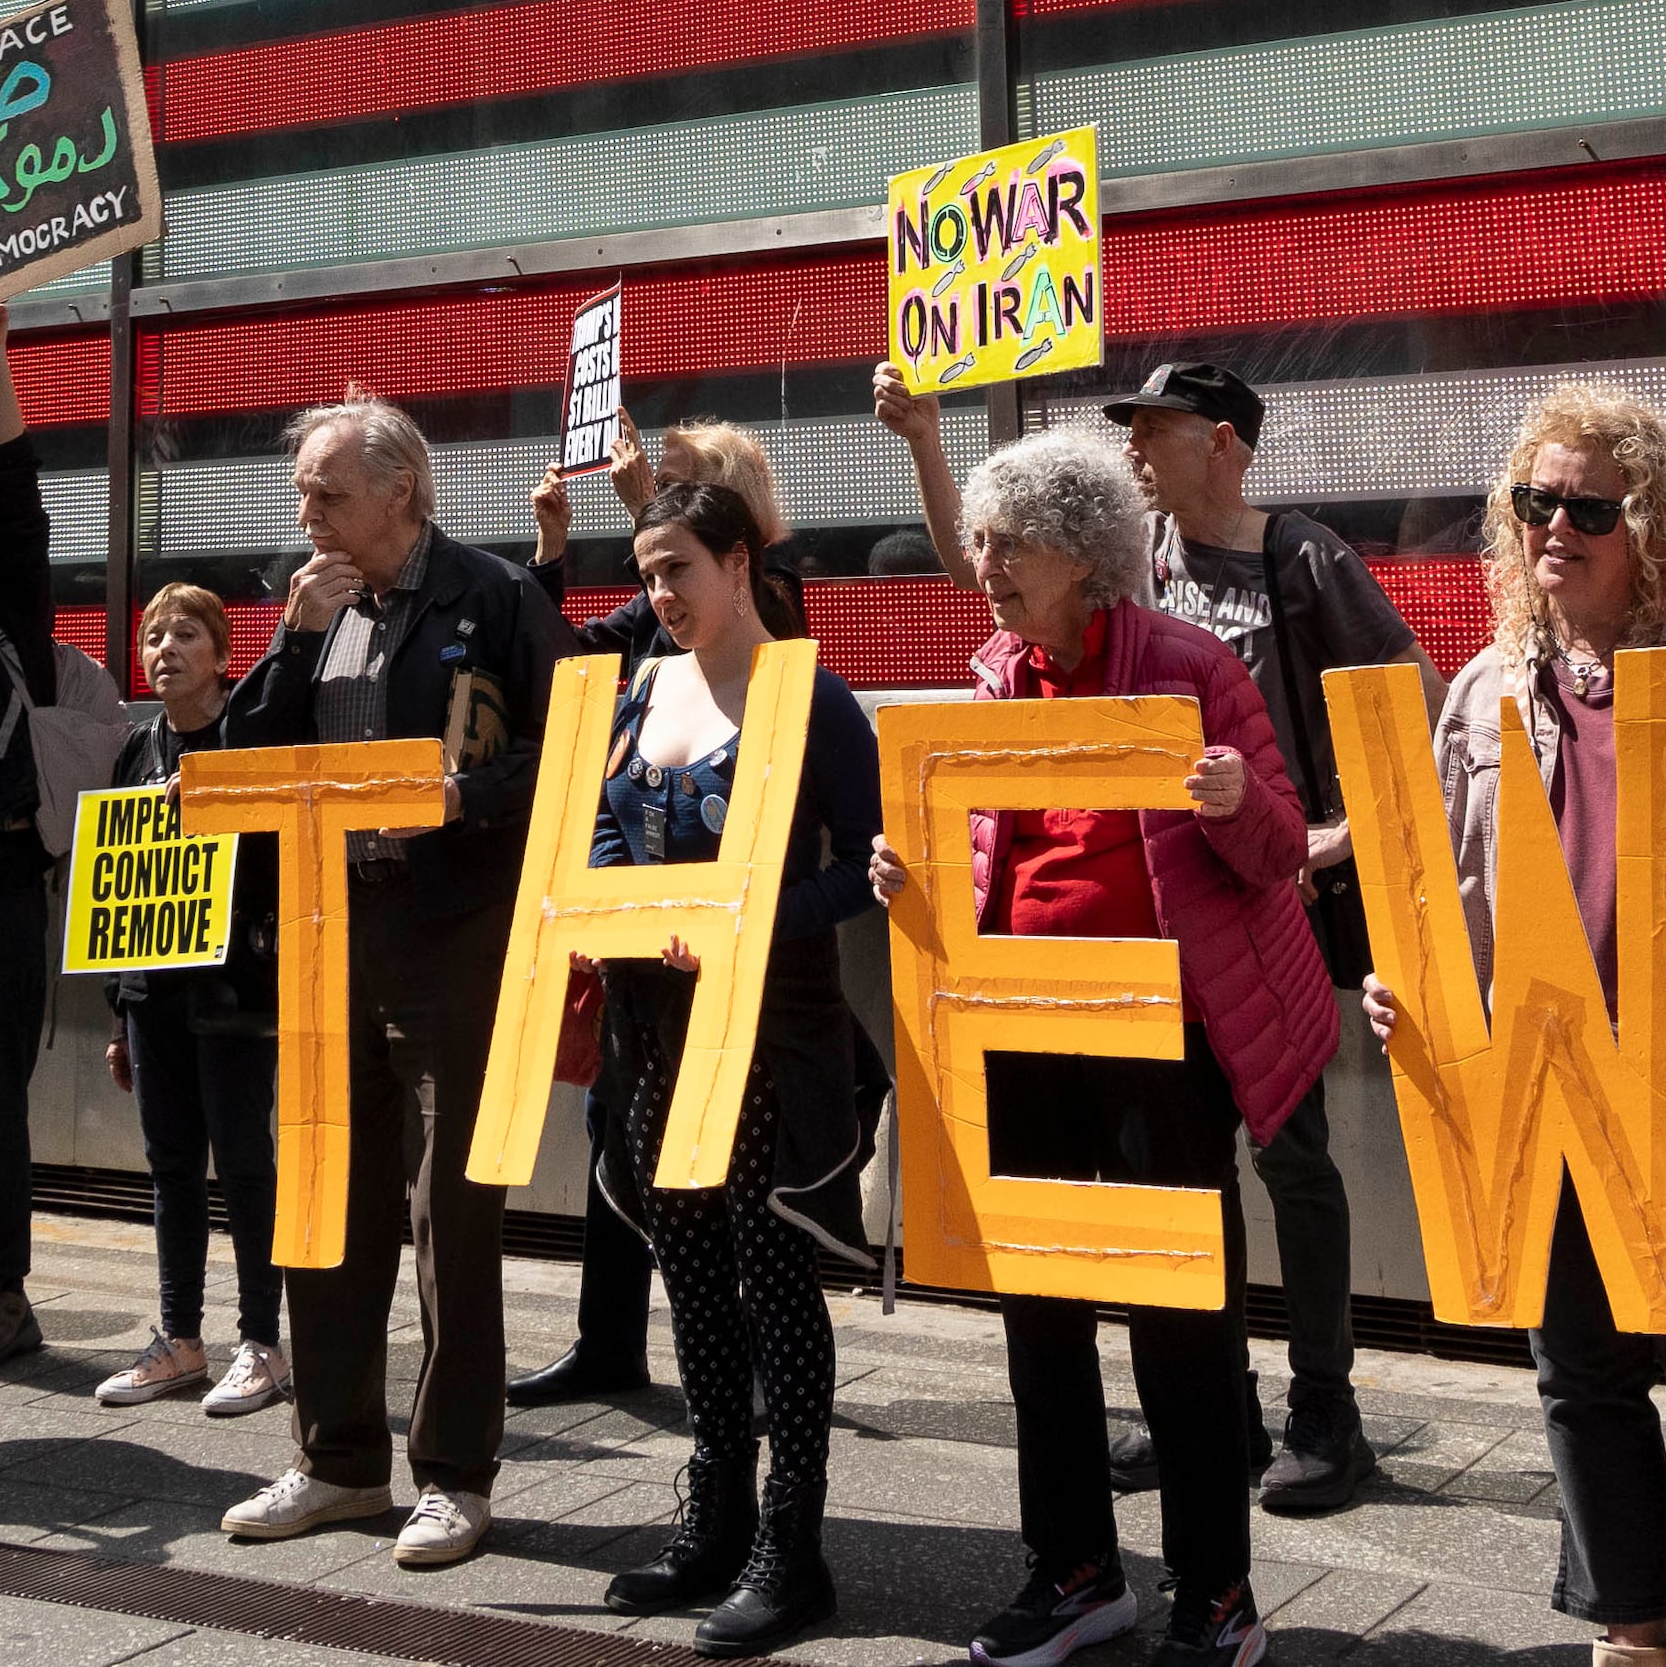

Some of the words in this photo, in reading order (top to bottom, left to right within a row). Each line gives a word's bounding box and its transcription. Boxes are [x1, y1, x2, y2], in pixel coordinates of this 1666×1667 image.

[896, 197, 968, 275] NO
[969, 170, 1092, 261] WAR
[899, 295, 958, 359] ON
[976, 271, 1094, 347] IRAN
[573, 338, 611, 388] COSTS
[1216, 586, 1273, 627] AND
[95, 795, 219, 848] IMPEA
[91, 842, 219, 903] CONVICT
[86, 898, 213, 960] REMOVE
